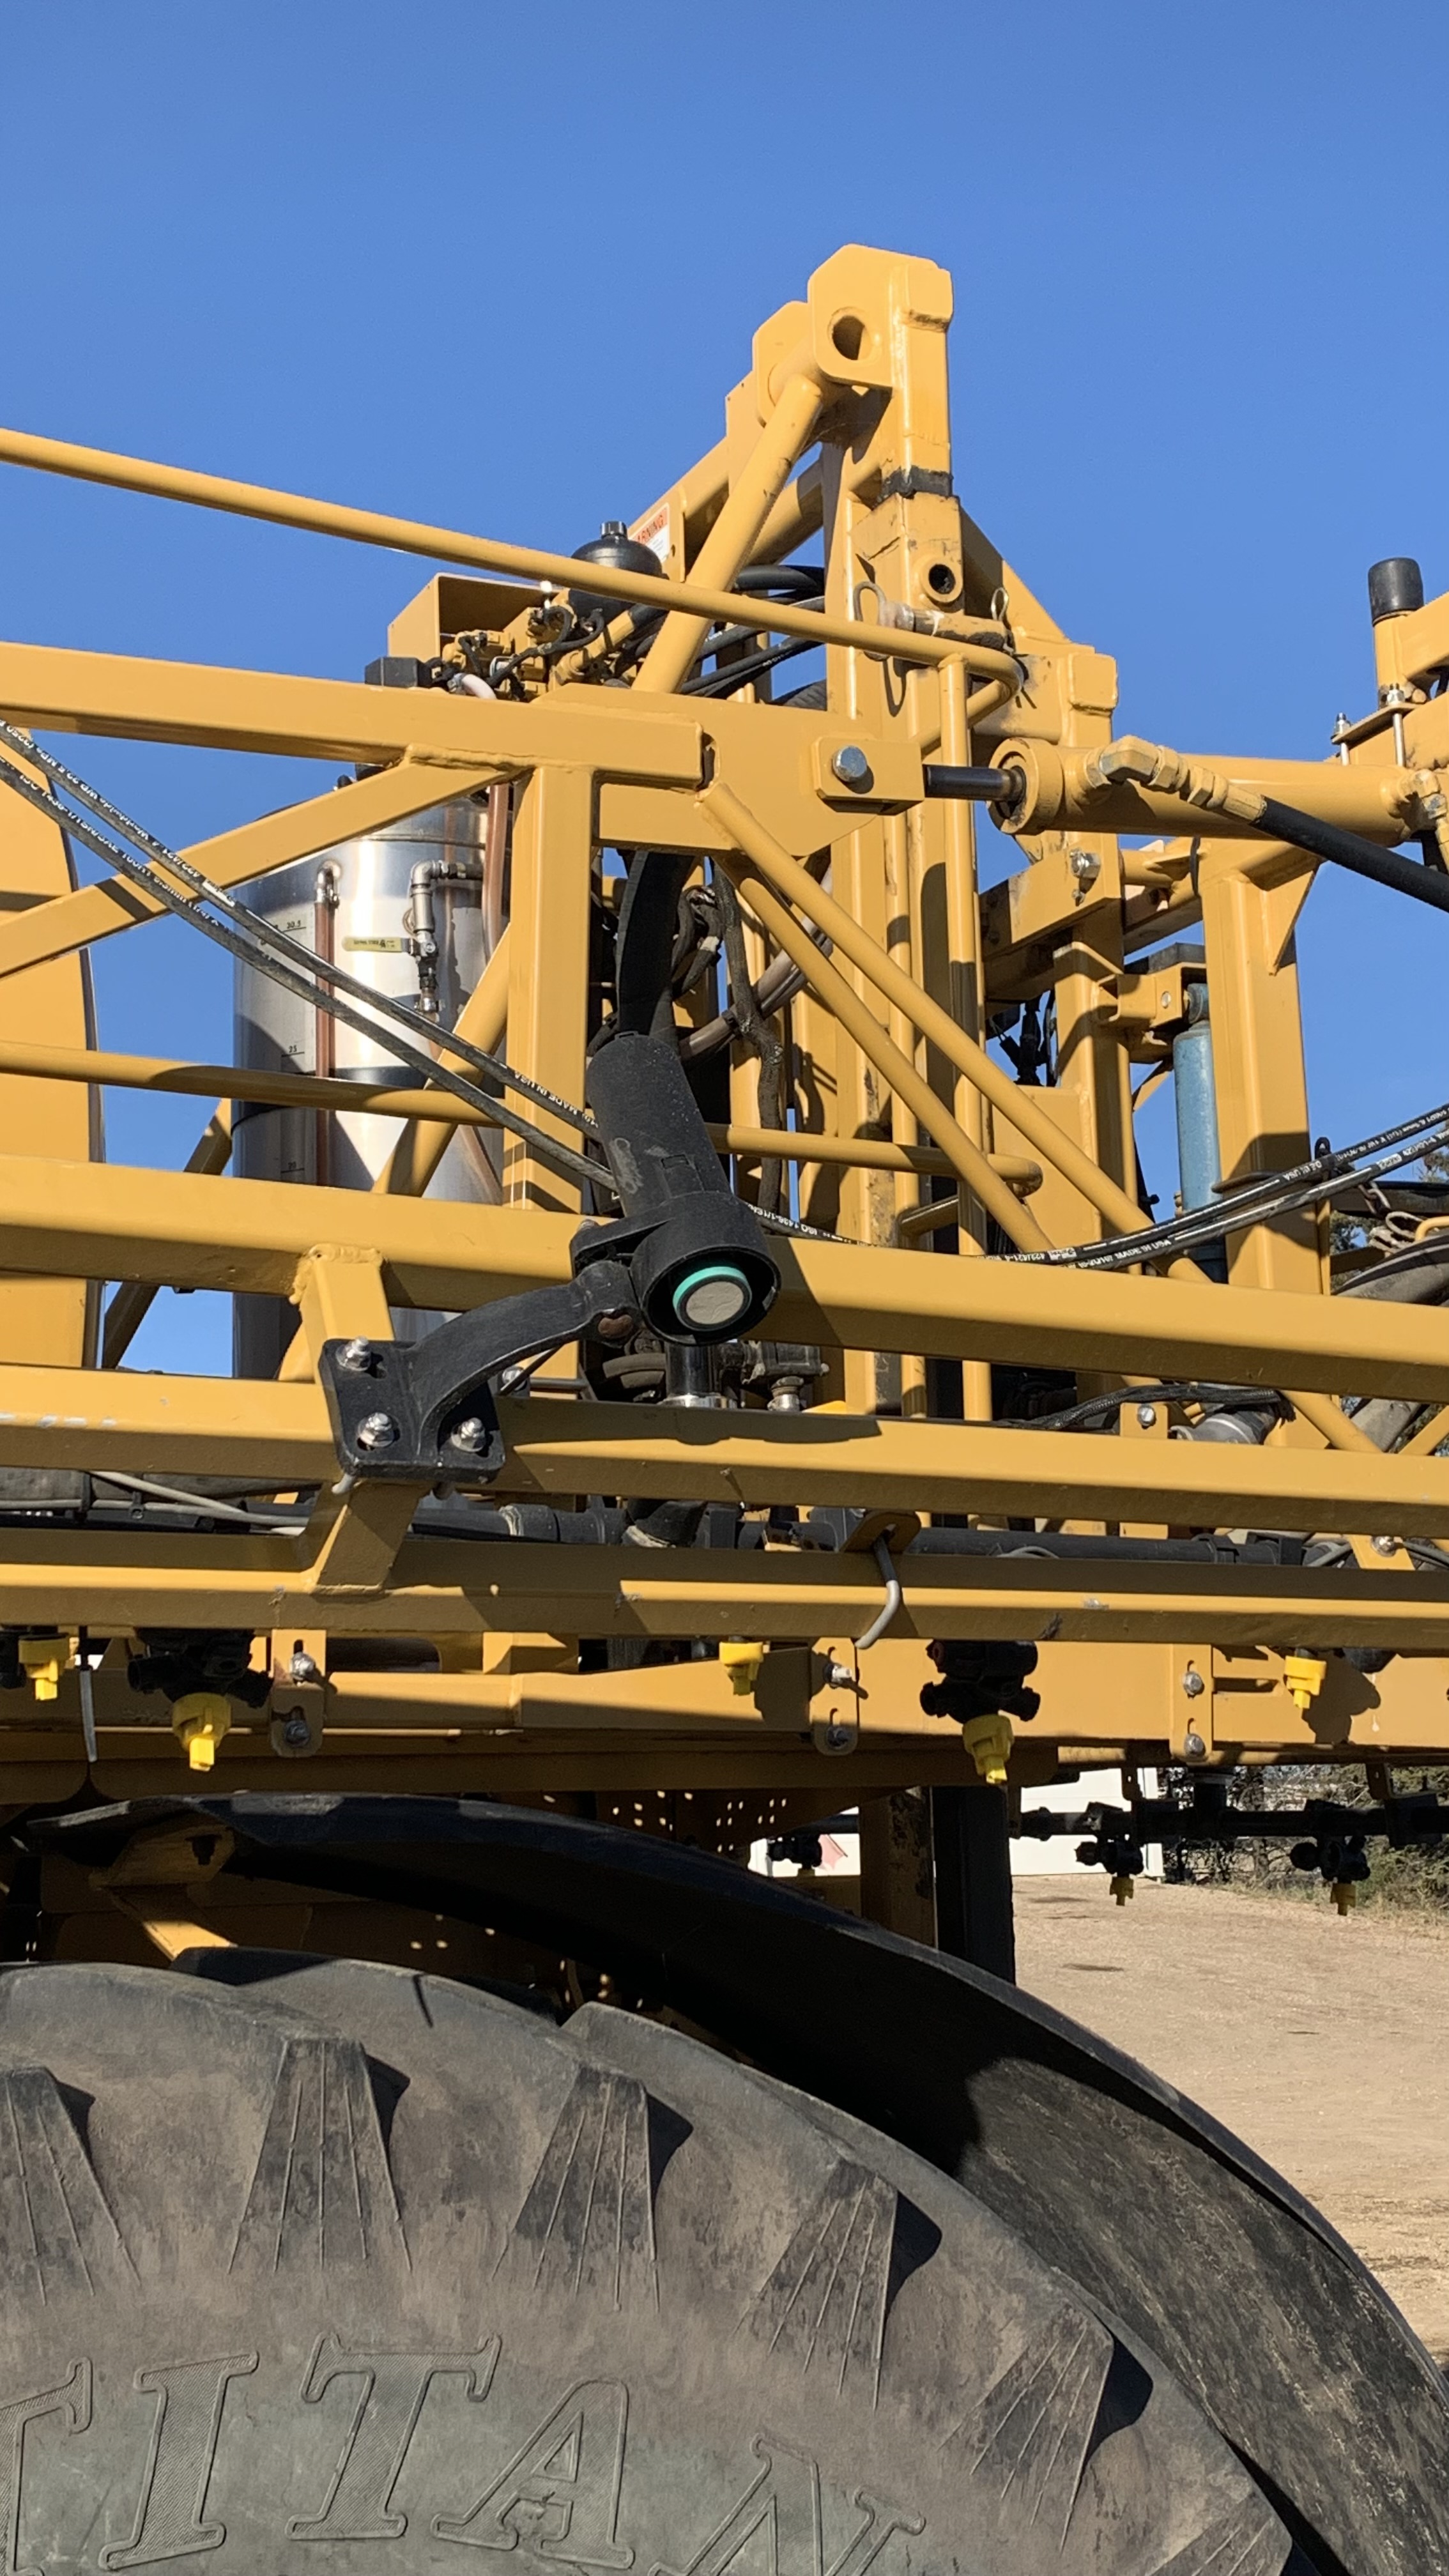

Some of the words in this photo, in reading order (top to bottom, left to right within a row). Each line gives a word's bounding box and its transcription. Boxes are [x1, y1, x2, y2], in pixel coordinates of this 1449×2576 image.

[288, 1044, 297, 1053] 25
[511, 1070, 536, 1089] USA
[535, 1084, 549, 1096] IN
[547, 1092, 579, 1116] MADE
